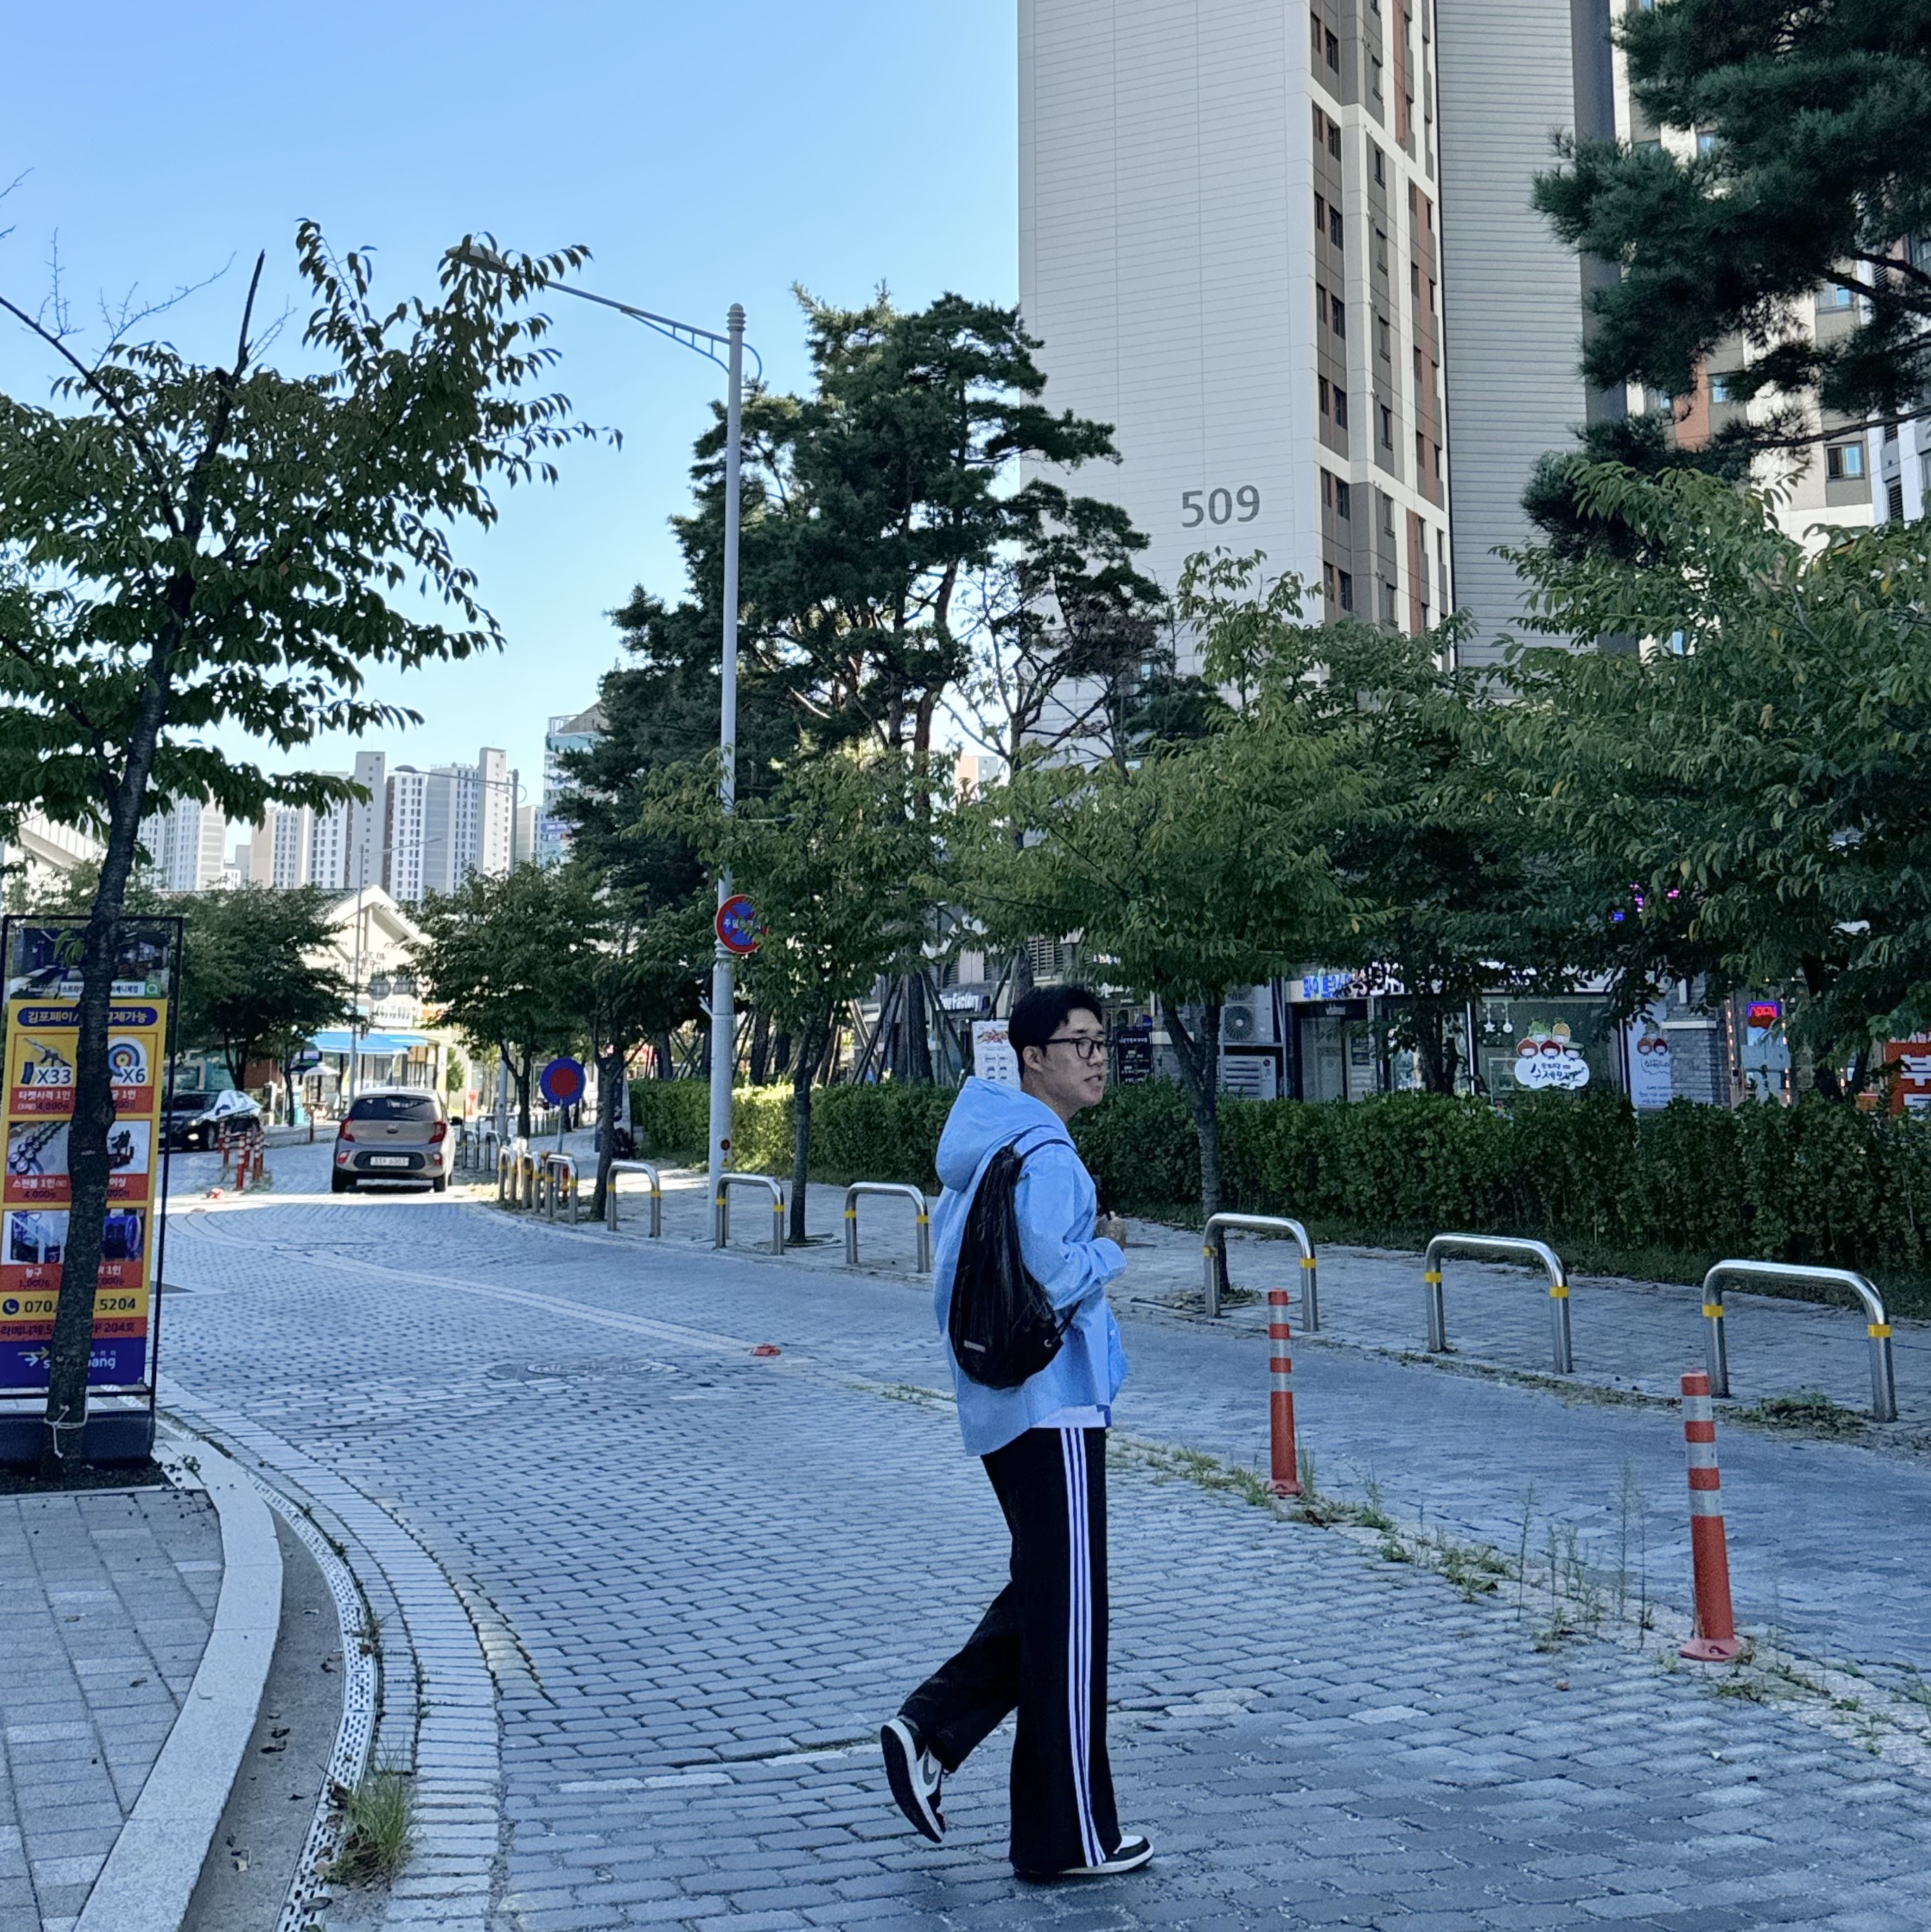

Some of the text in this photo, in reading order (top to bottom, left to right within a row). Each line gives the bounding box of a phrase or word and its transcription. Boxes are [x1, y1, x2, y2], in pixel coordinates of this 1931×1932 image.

[1182, 485, 1260, 527] 509
[37, 1069, 71, 1084] X33
[122, 1068, 146, 1083] X6
